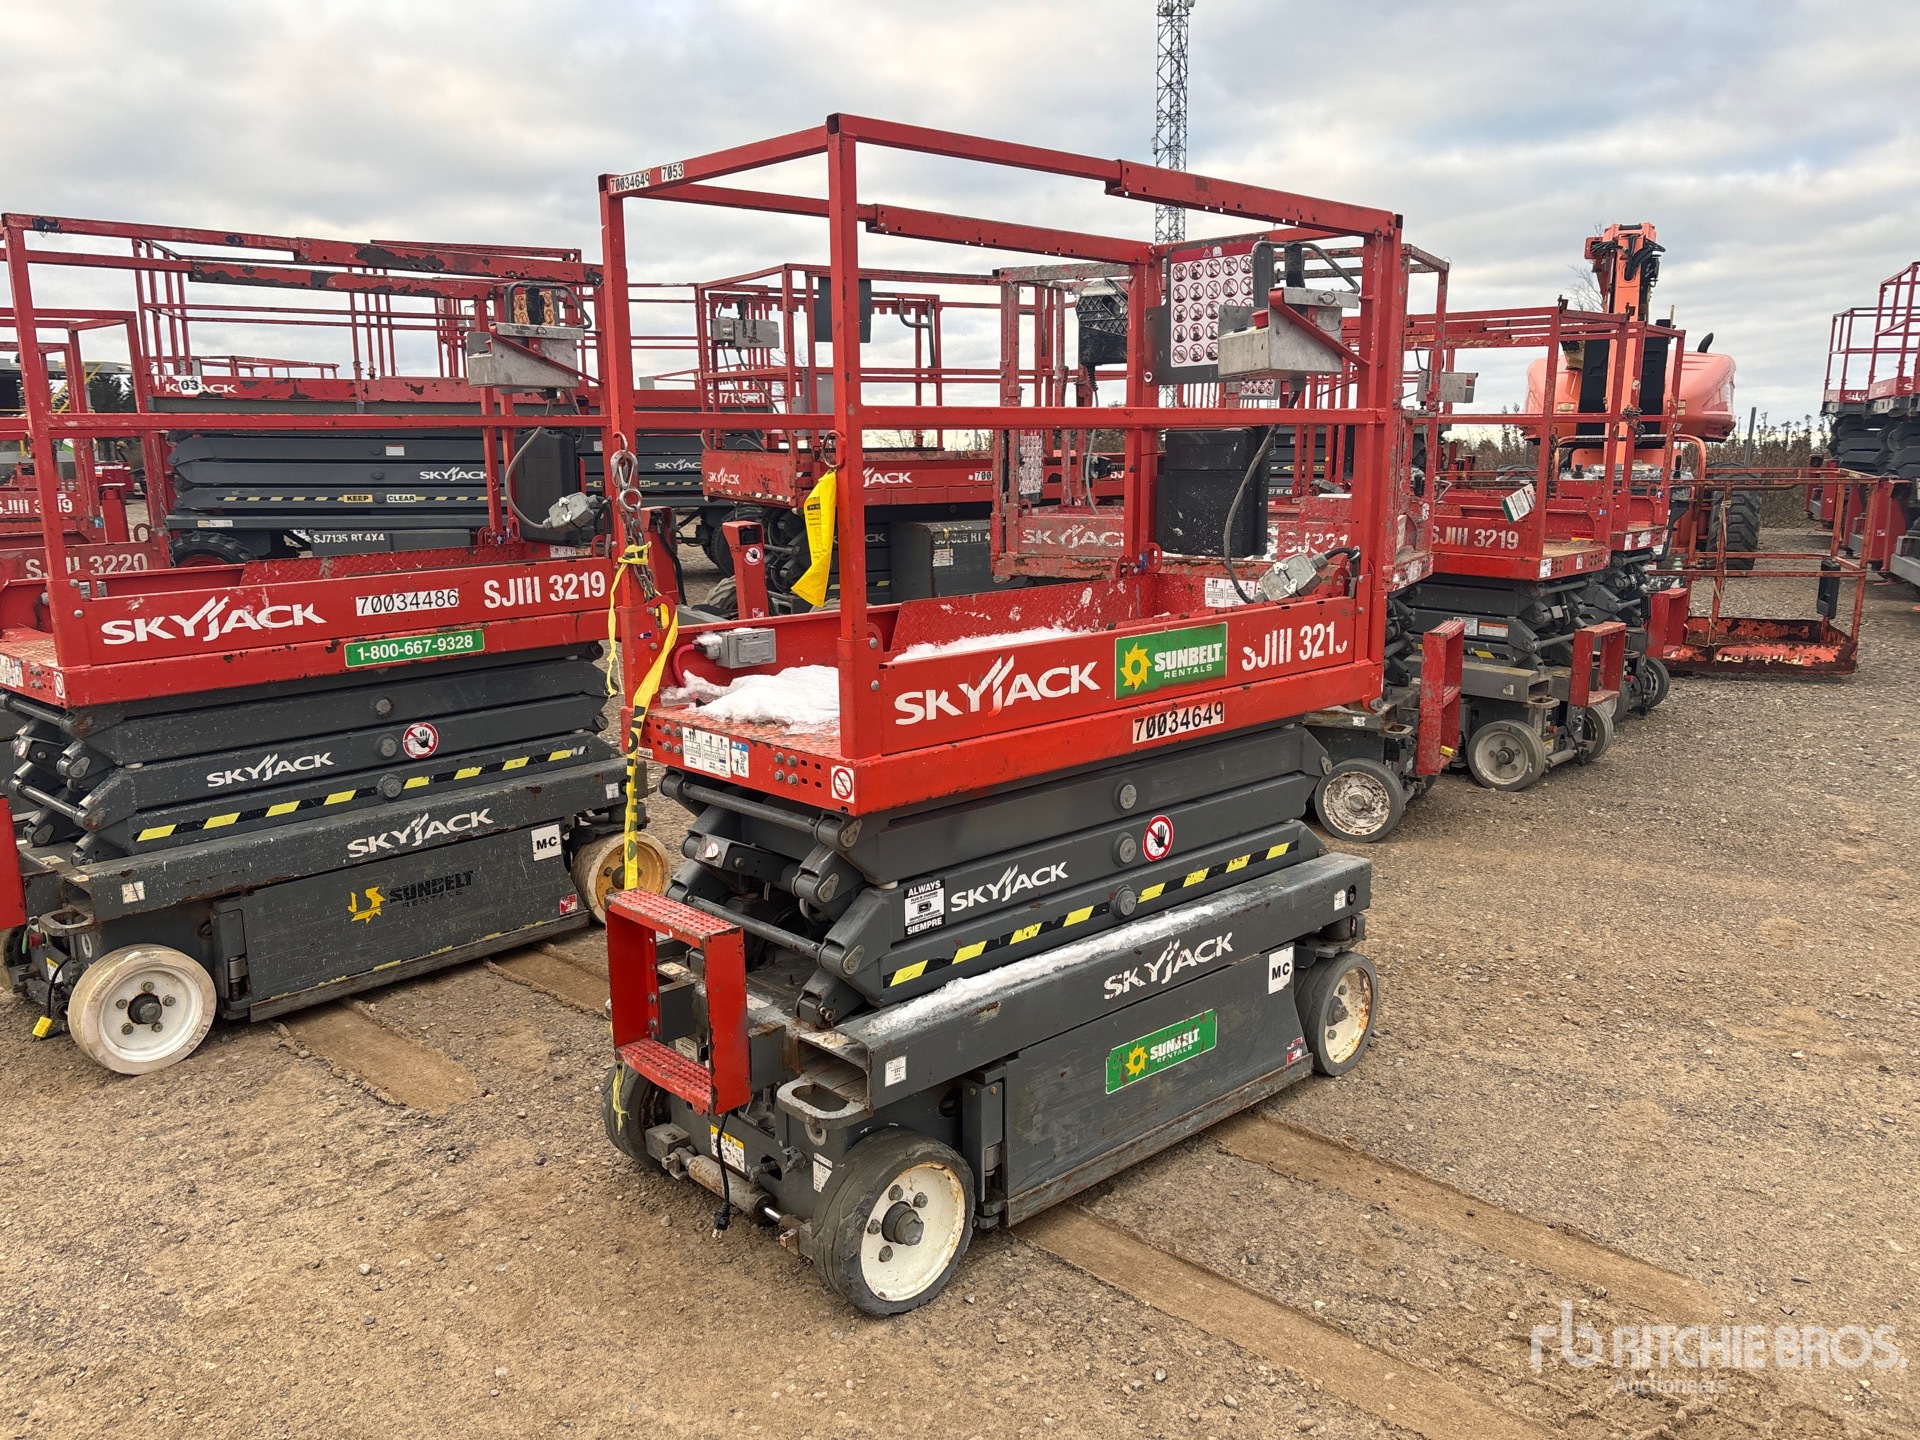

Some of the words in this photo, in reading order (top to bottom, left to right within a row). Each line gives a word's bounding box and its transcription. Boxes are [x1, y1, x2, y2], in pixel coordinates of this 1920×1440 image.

[610, 172, 650, 193] 70034649
[662, 163, 683, 180] 7053
[654, 458, 702, 471] SKYJAC
[975, 471, 992, 480] 700
[863, 466, 913, 488] JACK
[34, 498, 73, 514] 319
[313, 533, 348, 544] SJ7135
[351, 533, 364, 542] RT
[364, 532, 386, 542] 4X4
[1021, 524, 1124, 549] SKYJAC
[1473, 528, 1520, 550] 3219
[88, 553, 148, 576] 3220
[483, 575, 542, 610] SJIII
[548, 570, 606, 602] 3219
[357, 589, 459, 615] 70034486
[100, 595, 328, 646] SKYJACK
[356, 634, 474, 662] 1-800-667-9328
[1154, 642, 1223, 672] SUNBELT
[1163, 663, 1213, 679] RENTALS
[893, 654, 1102, 726] SKYJACK
[1133, 700, 1224, 741] 70034649
[206, 751, 336, 788] SKYJACK
[346, 807, 494, 858] SKYJACK
[536, 836, 558, 850] MC
[908, 880, 941, 898] ALWAYS
[950, 861, 1069, 912] SKYJACK
[907, 917, 942, 935] SIEMPRE
[1103, 931, 1234, 1000] SKYJACK
[1271, 961, 1290, 981] MC
[1149, 1027, 1200, 1061] SUNBELT
